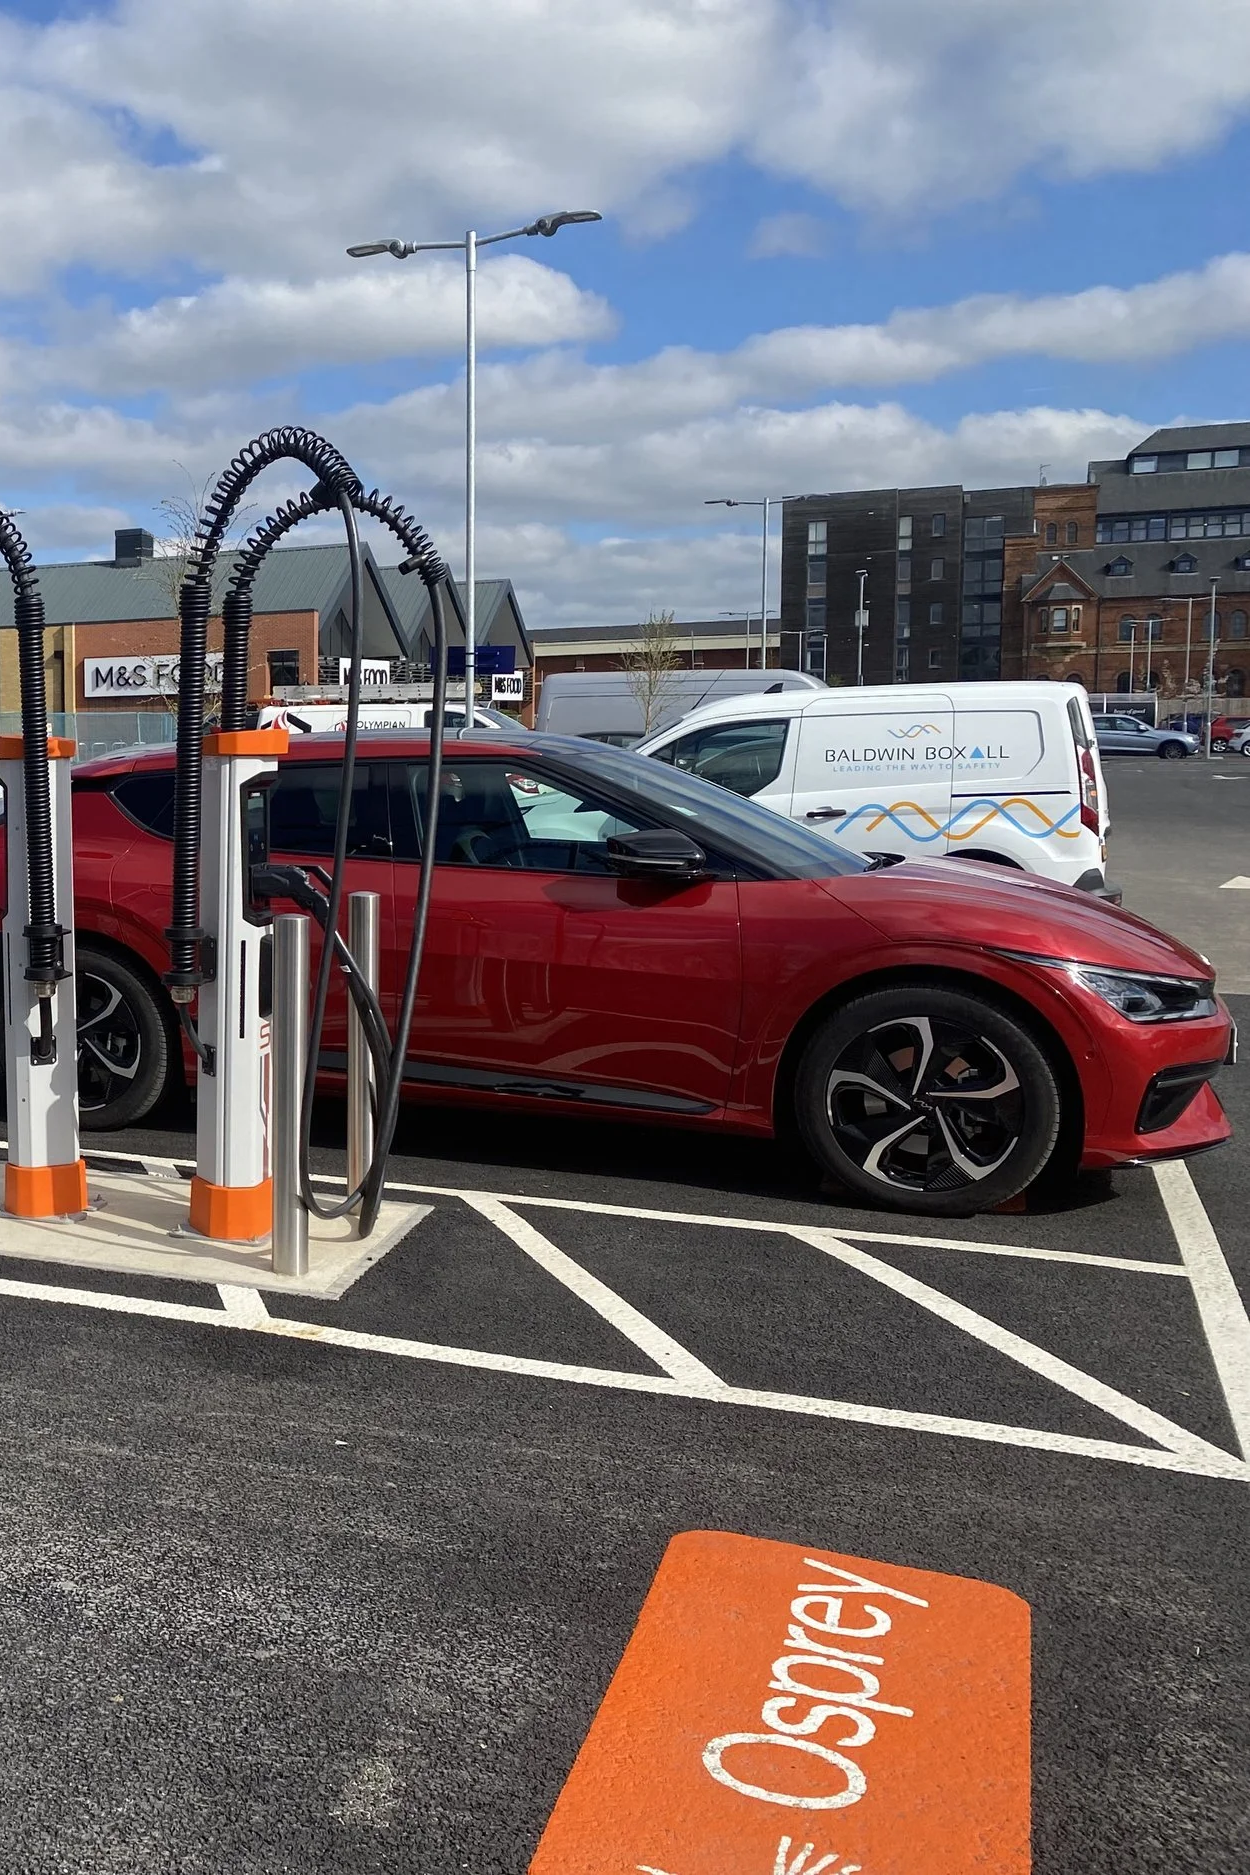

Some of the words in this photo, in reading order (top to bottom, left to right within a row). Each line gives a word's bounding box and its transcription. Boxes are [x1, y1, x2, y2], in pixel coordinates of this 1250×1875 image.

[95, 664, 147, 688] M&S
[363, 668, 388, 685] FOOD
[507, 677, 522, 694] FOOD
[356, 720, 406, 729] OLYMPIAN
[825, 748, 915, 763] BALDWIN
[832, 765, 881, 773] LEADING
[910, 763, 934, 771] WAY
[957, 762, 1001, 770] SAFETY
[701, 1556, 930, 1811] Osprey
